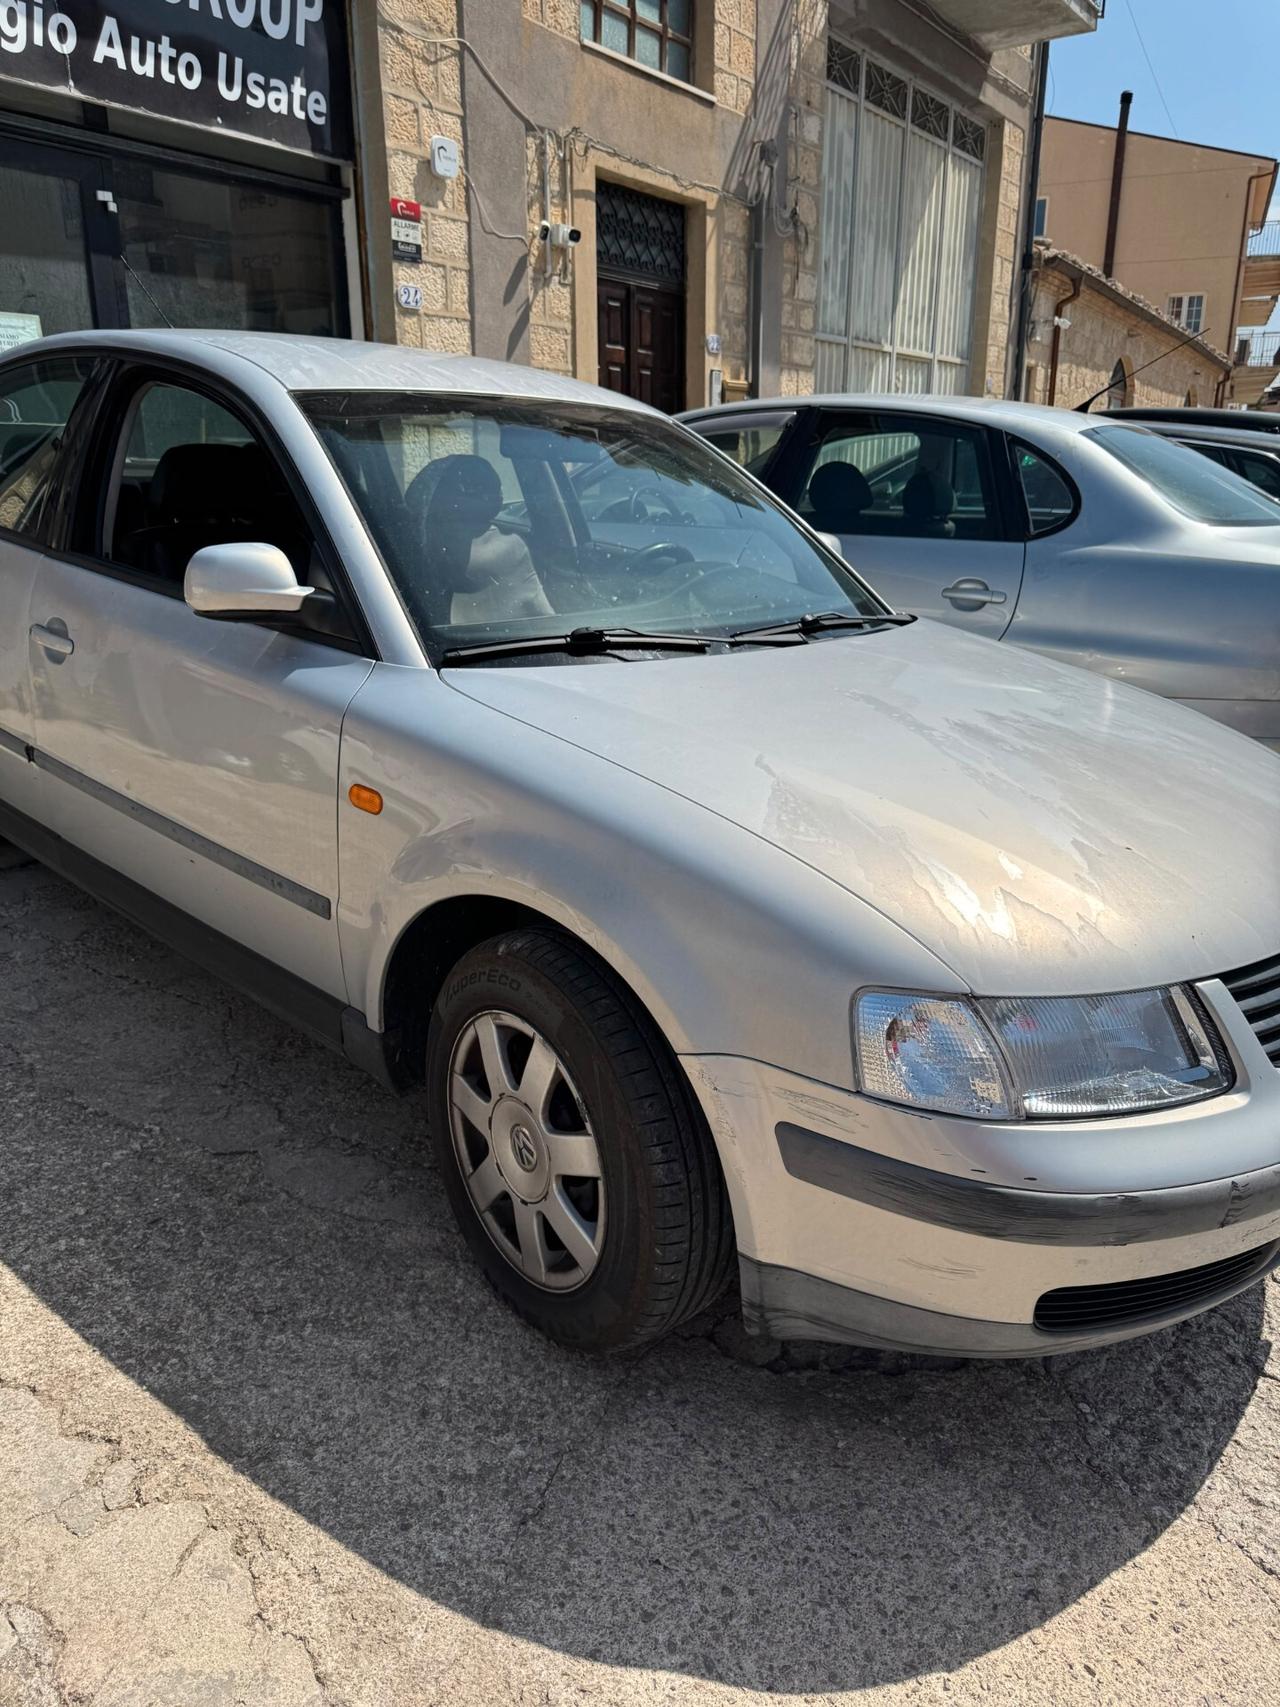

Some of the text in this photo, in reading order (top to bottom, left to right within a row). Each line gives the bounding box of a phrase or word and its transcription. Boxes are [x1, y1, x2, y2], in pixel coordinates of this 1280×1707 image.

[93, 16, 202, 90] Auto
[217, 52, 327, 125] Usate
[403, 288, 420, 306] 24
